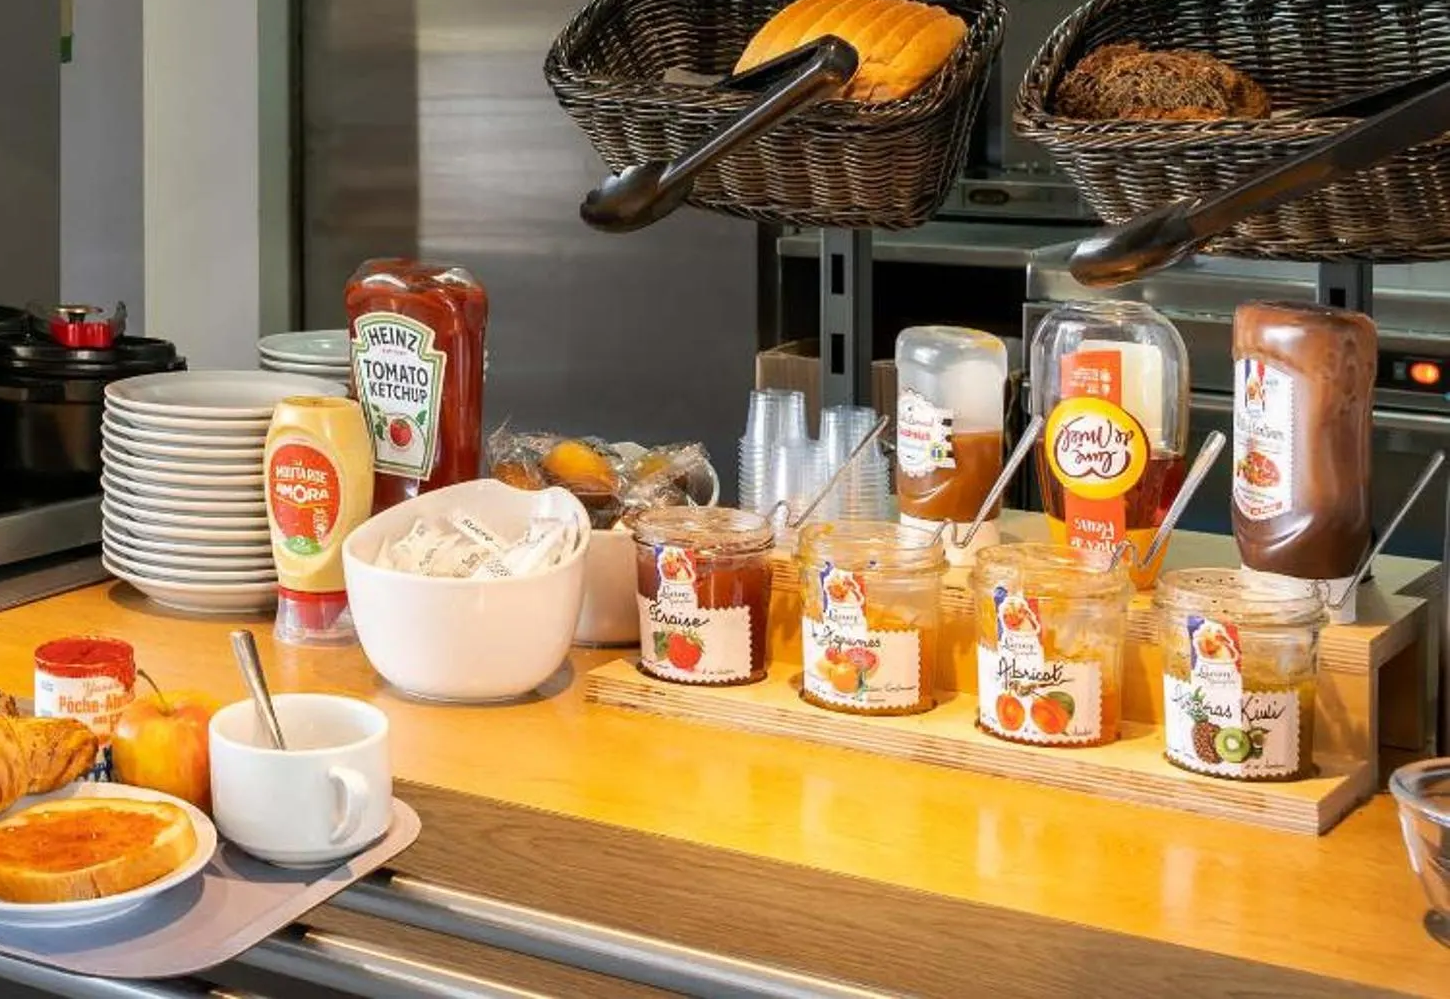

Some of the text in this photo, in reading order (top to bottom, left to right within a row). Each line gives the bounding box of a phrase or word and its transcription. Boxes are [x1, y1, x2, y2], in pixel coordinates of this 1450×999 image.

[367, 325, 419, 353] HEINZ
[363, 357, 430, 388] TOMATO
[369, 377, 429, 405] KETCHUP
[275, 482, 330, 504] AMORA
[648, 600, 711, 628] Fraise
[997, 656, 1064, 691] Abricot
[1240, 695, 1287, 722] Kiwi
